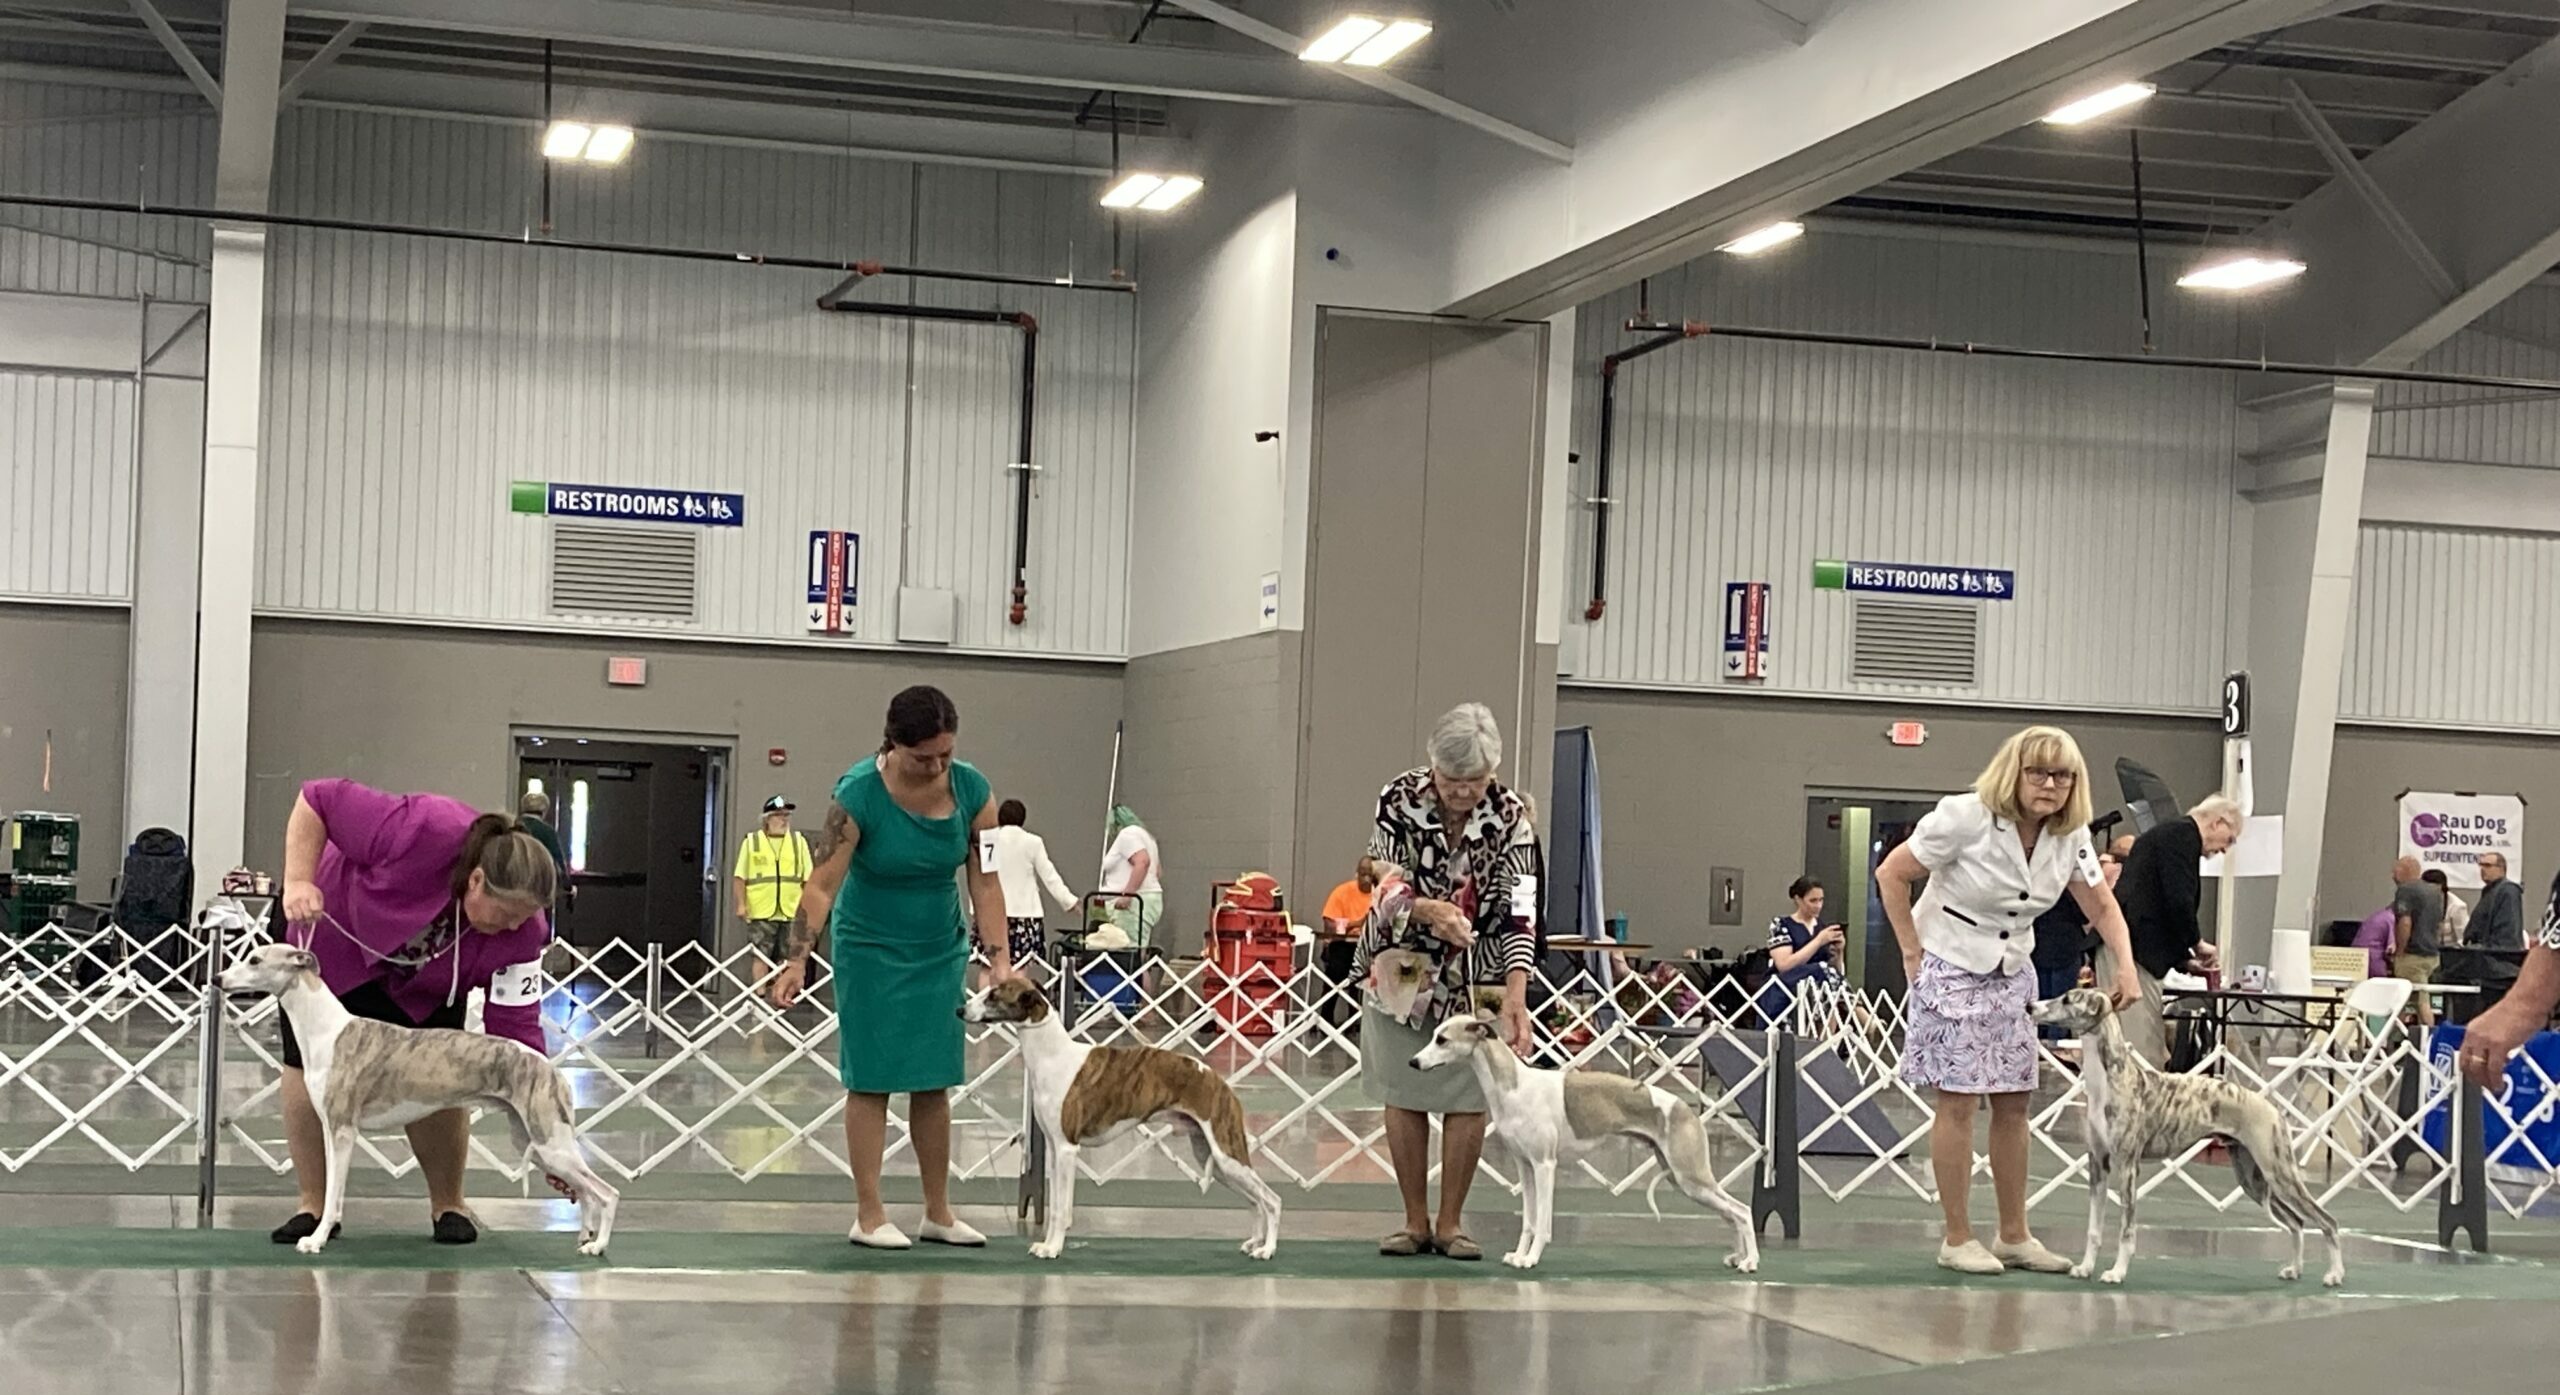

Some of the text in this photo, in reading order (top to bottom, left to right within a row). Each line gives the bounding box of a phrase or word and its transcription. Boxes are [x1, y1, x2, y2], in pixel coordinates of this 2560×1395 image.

[555, 490, 679, 516] RESTROOMS
[1852, 567, 1959, 591] RESTROOMS
[2225, 680, 2240, 732] 3
[2440, 814, 2507, 834] Rau Dog
[2438, 830, 2493, 847] Shows
[984, 843, 994, 861] 7
